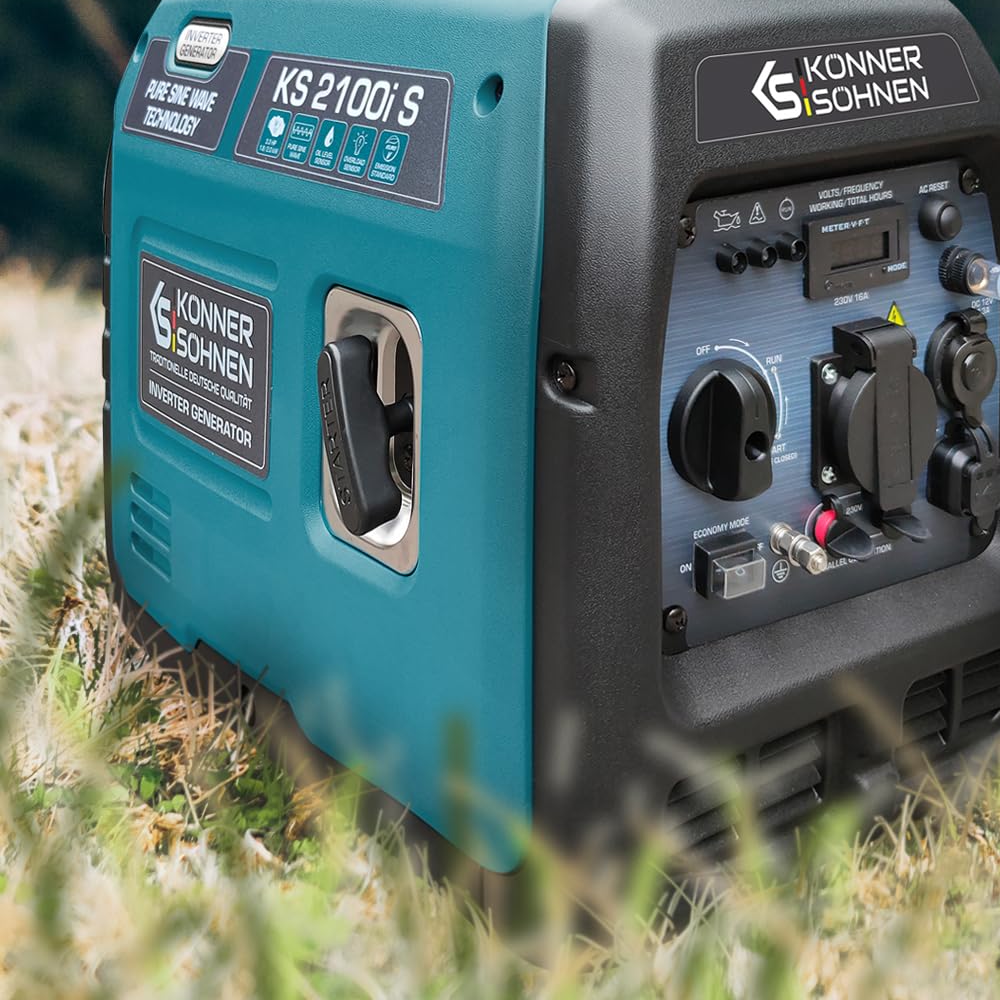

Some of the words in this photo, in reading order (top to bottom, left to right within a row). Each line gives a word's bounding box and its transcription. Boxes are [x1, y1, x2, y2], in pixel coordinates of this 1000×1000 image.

[185, 29, 223, 45] INVERTER
[179, 43, 217, 60] GENERATOR
[144, 79, 171, 101] PURE
[167, 83, 191, 106] SINE
[188, 89, 218, 112] WAVE
[272, 66, 313, 107] KS
[311, 72, 400, 122] 2100i
[397, 85, 425, 127] S
[143, 105, 201, 137] TECHNOLOGY
[313, 157, 332, 167] SENSOR
[343, 155, 366, 167] OVERLOAD
[343, 163, 361, 174] SENSOR
[370, 170, 396, 182] STANDARD
[918, 185, 929, 195] AC
[928, 181, 950, 192] RESET
[867, 190, 894, 202] HOURS
[887, 261, 908, 273] MODE
[833, 295, 853, 306] 230V
[854, 291, 869, 302] 16A
[971, 300, 981, 309] DC
[696, 344, 711, 356] OFF
[766, 354, 782, 366] RUN
[149, 350, 189, 380] TRADITIONELLE
[188, 370, 220, 396] DEUTSCHE
[220, 385, 253, 411] QUALITÄT
[148, 379, 190, 416] INVERTER
[191, 403, 253, 449] GENERATOR
[845, 504, 863, 515] 230V
[693, 522, 729, 540] ECONOMY
[729, 516, 750, 530] MODE
[679, 562, 692, 574] ON
